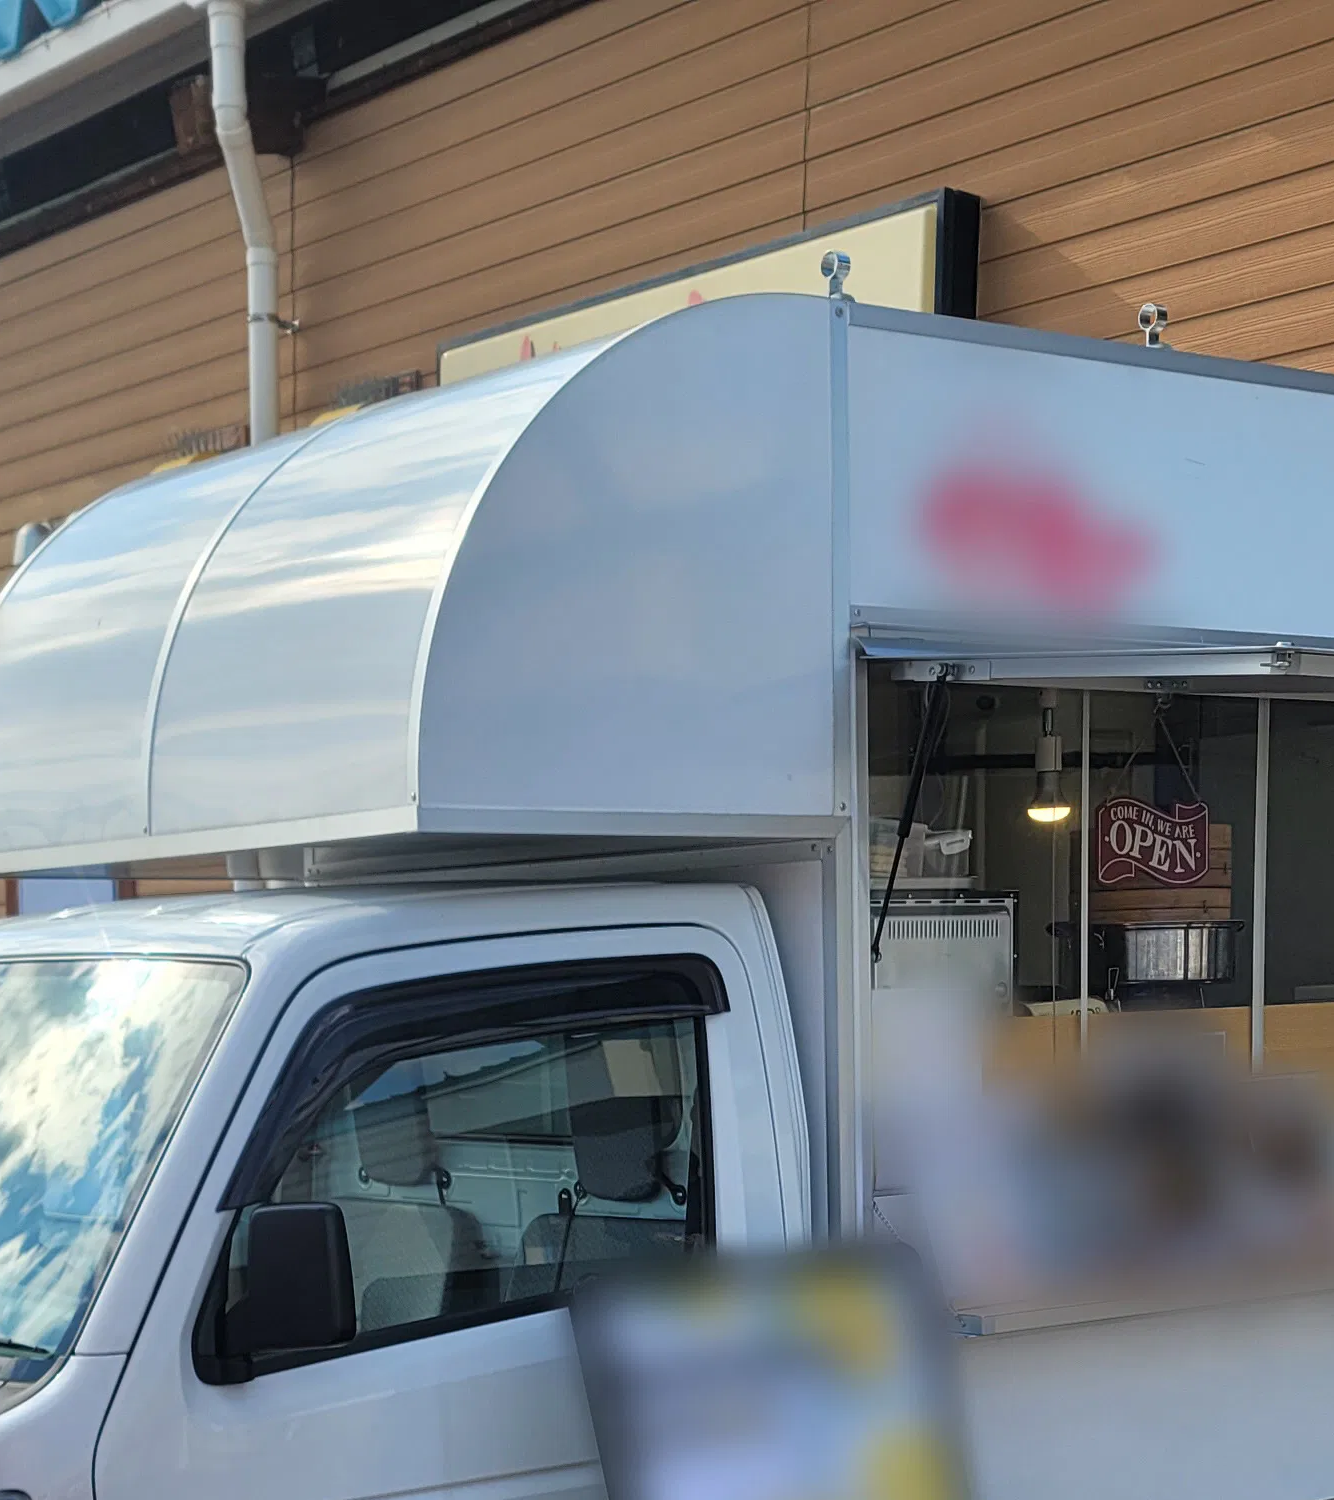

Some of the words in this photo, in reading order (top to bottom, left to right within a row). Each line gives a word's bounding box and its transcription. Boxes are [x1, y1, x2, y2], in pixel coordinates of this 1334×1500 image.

[1110, 805, 1139, 821] COME
[1157, 818, 1171, 836] WE
[1174, 823, 1196, 839] ARE
[1109, 820, 1198, 873] OPEN
